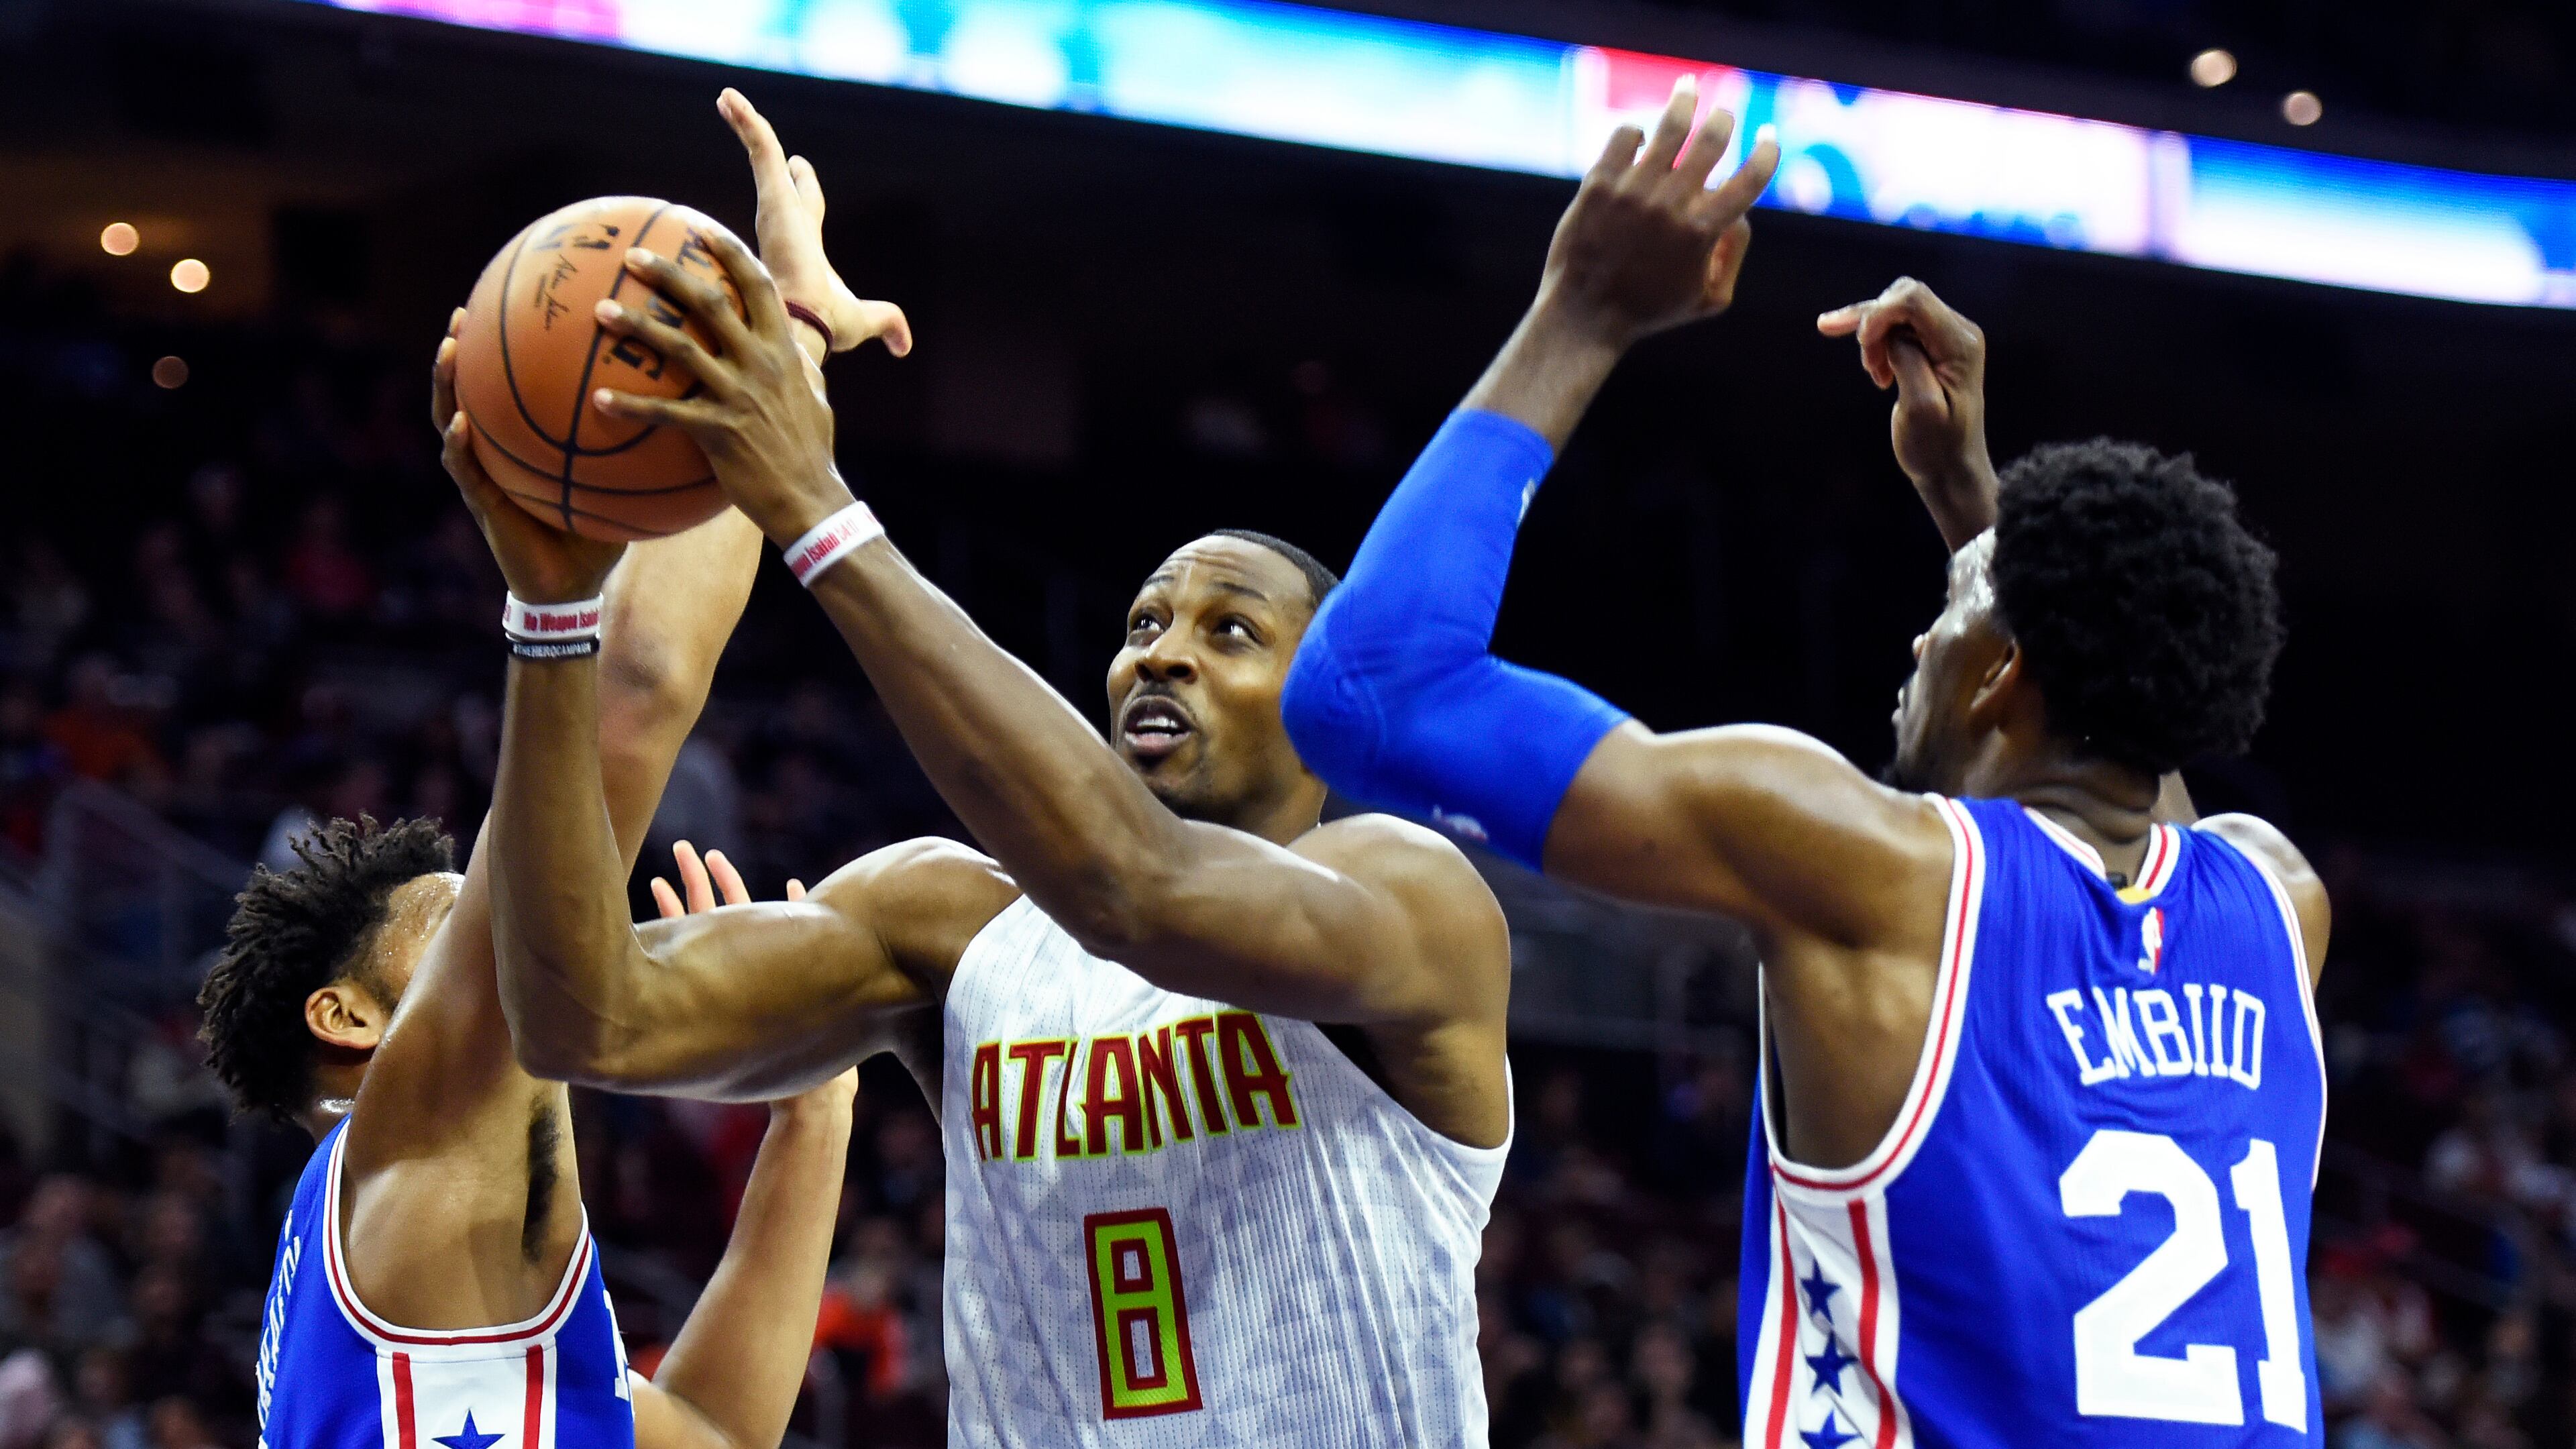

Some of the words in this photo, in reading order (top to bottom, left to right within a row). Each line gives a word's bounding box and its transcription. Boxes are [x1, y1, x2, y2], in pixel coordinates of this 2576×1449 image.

[971, 1009, 1302, 1163] ATLANTA
[2046, 982, 2266, 1091] EMBIID
[1083, 1207, 1204, 1421] 8
[2058, 1129, 2308, 1436] 21
